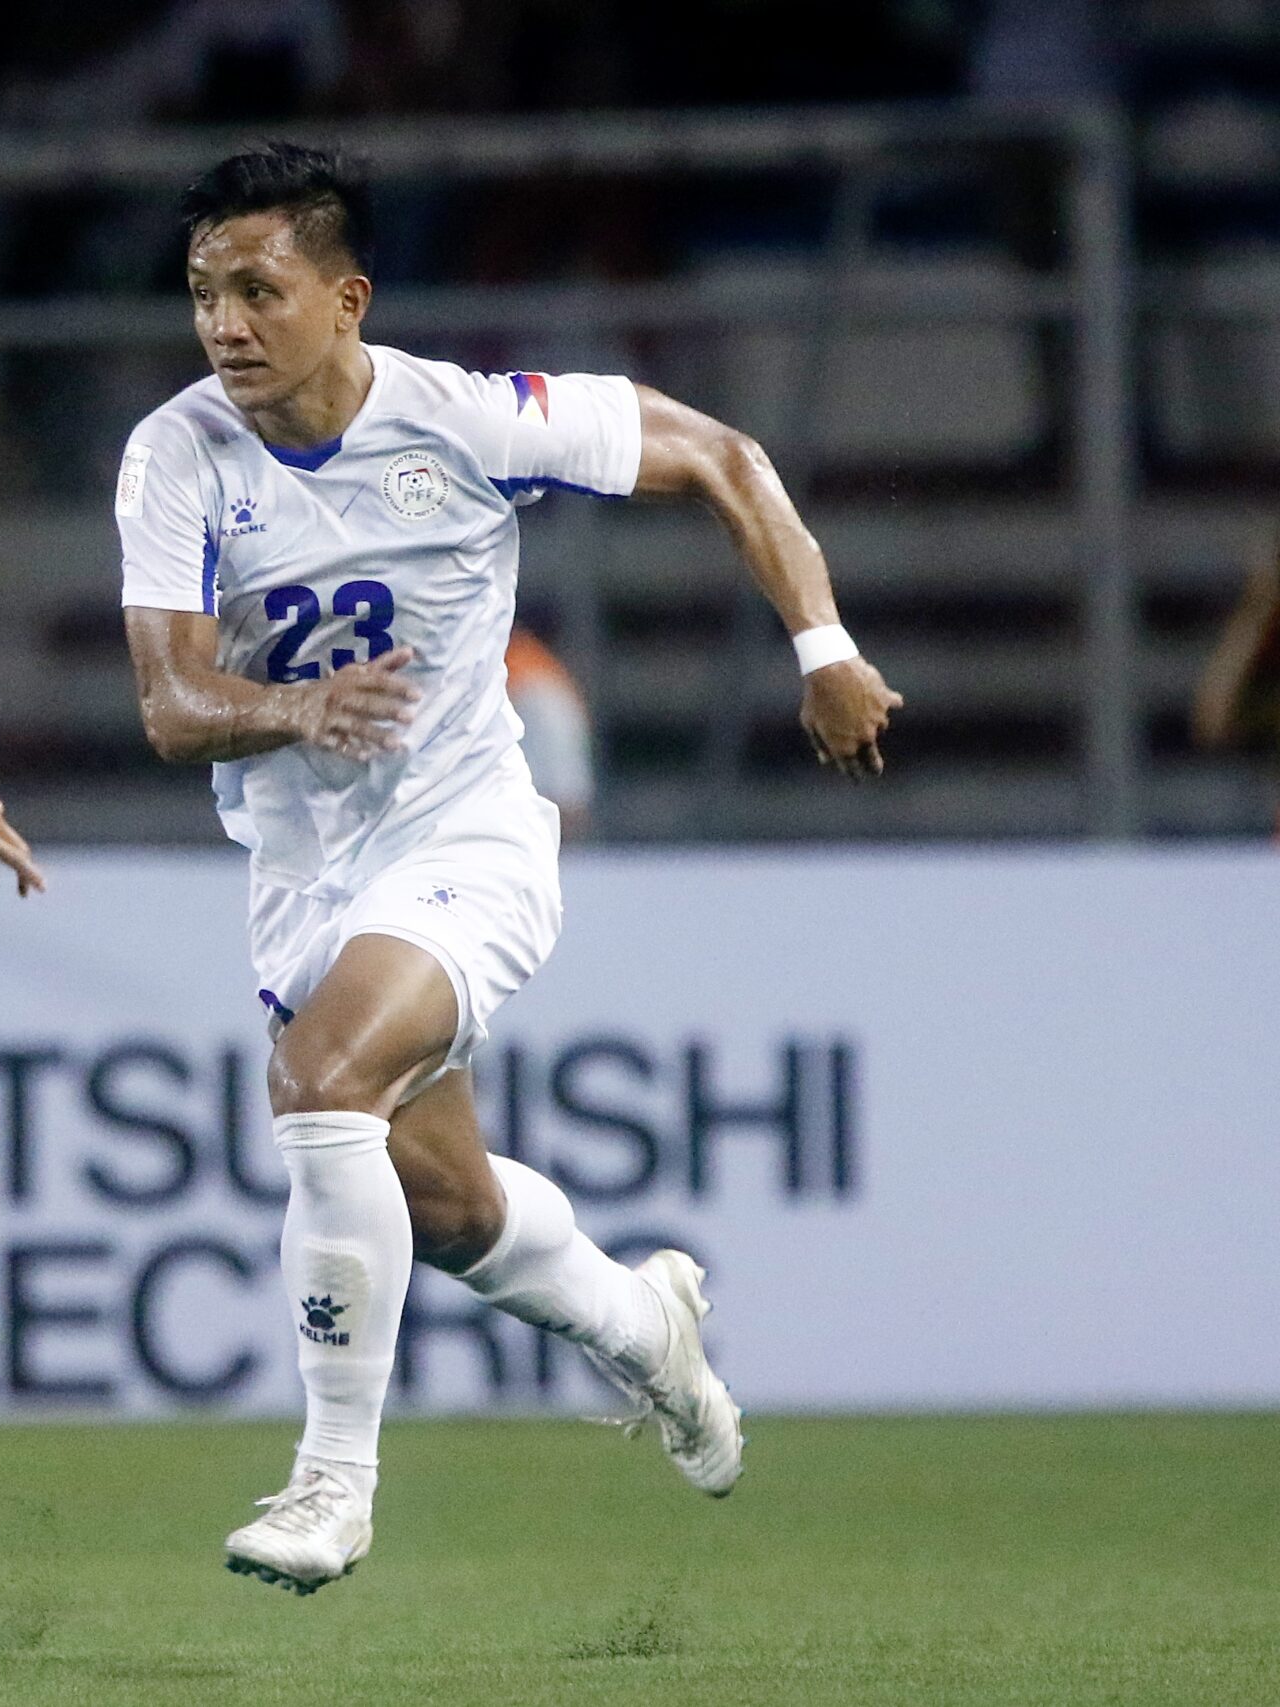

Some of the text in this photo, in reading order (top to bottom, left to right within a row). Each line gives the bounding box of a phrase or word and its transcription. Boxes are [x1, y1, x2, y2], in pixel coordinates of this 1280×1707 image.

[219, 523, 267, 537] KELME
[264, 579, 395, 684] 23
[299, 1322, 350, 1347] KELME
